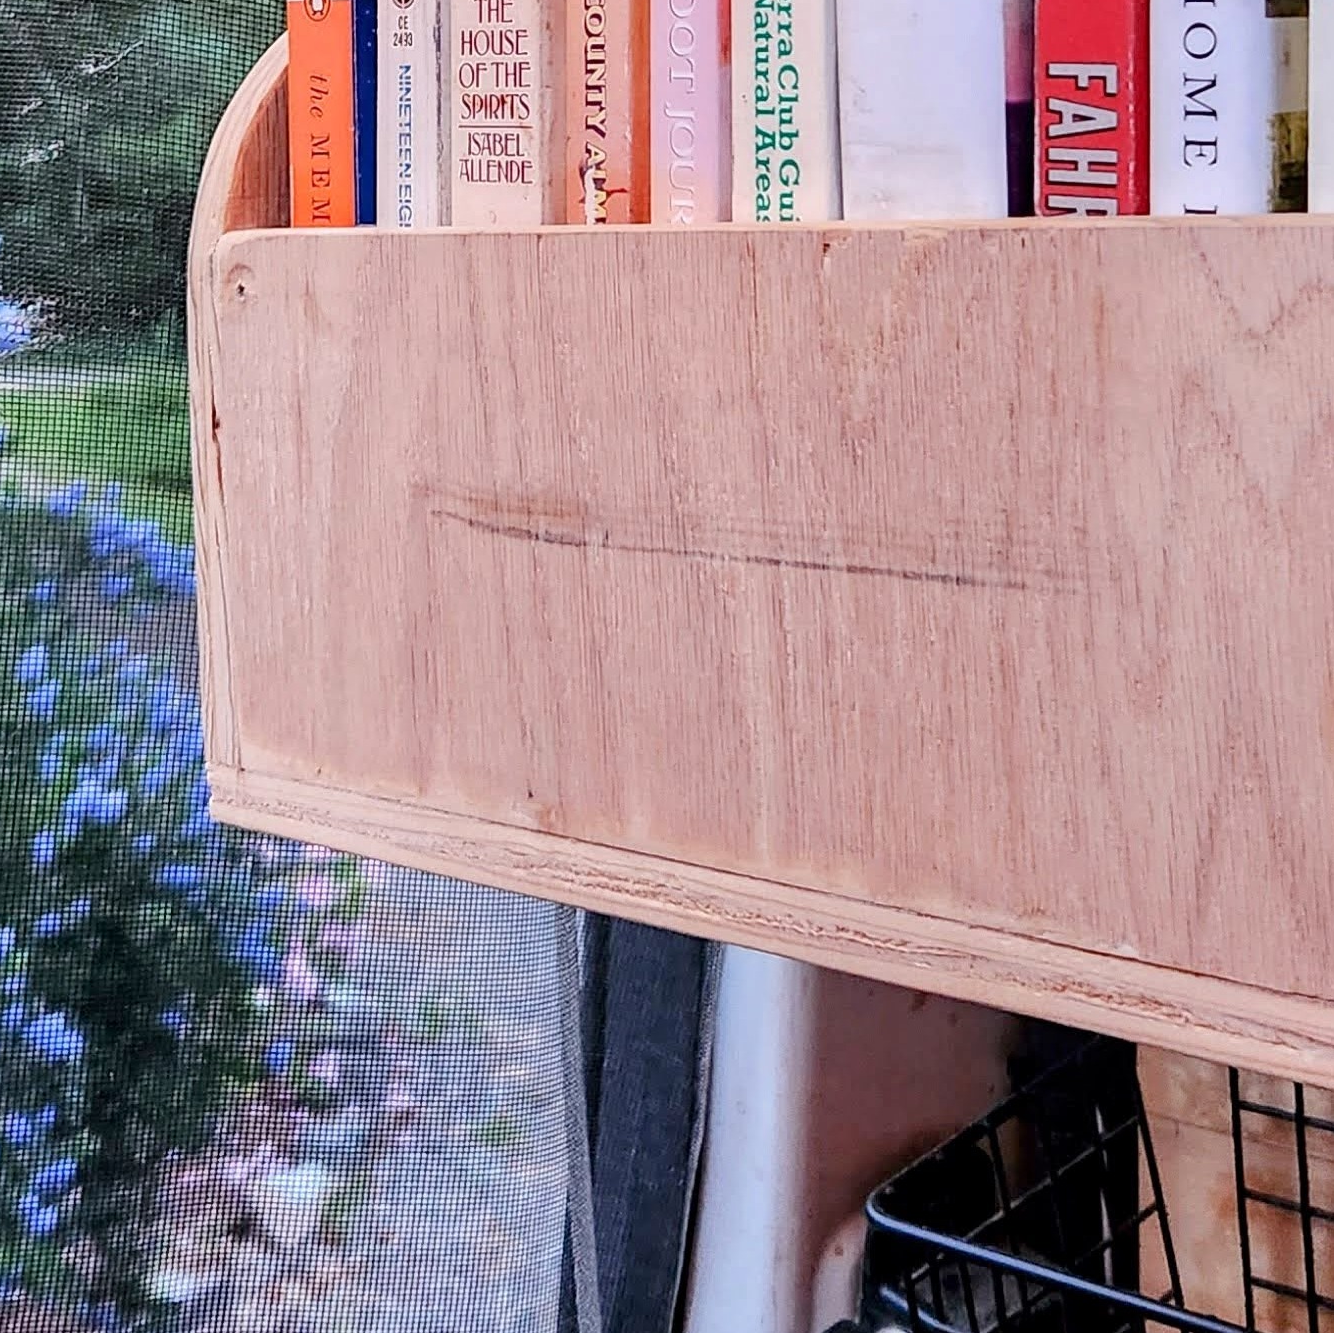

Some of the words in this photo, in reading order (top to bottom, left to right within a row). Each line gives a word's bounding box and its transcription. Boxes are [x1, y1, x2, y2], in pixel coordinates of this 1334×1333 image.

[398, 16, 409, 30] CE
[460, 30, 529, 56] HOUSE
[459, 62, 489, 89] OF
[490, 61, 531, 88] THE
[309, 73, 331, 118] the
[461, 94, 531, 120] SPIRITS
[777, 64, 800, 151] Club
[398, 65, 412, 178] NINETEEN
[467, 133, 525, 156] ISABEL
[310, 134, 332, 223] MEM
[459, 159, 533, 184] ALLENDE
[398, 185, 412, 227] EIG
[779, 159, 803, 222] Gui
